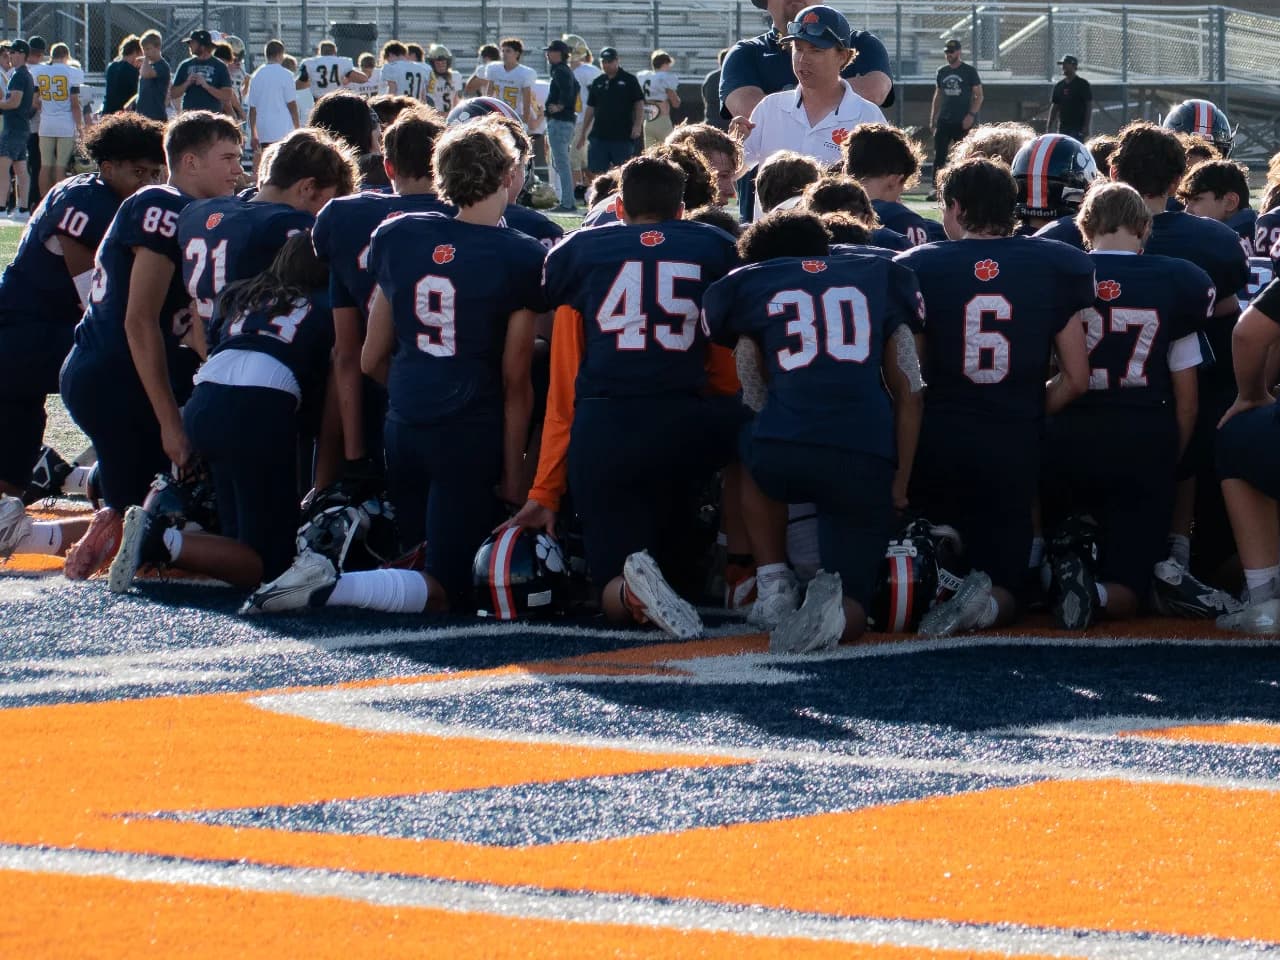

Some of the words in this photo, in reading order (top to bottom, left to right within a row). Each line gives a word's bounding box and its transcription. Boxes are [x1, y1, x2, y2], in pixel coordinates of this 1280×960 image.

[36, 74, 69, 102] 23
[316, 64, 341, 89] 34
[57, 206, 89, 238] 10
[142, 206, 179, 238] 85
[184, 237, 228, 320] 21
[414, 274, 457, 358] 9
[595, 259, 701, 352] 45
[766, 286, 871, 372] 30
[963, 293, 1013, 384] 6
[1081, 306, 1160, 390] 27
